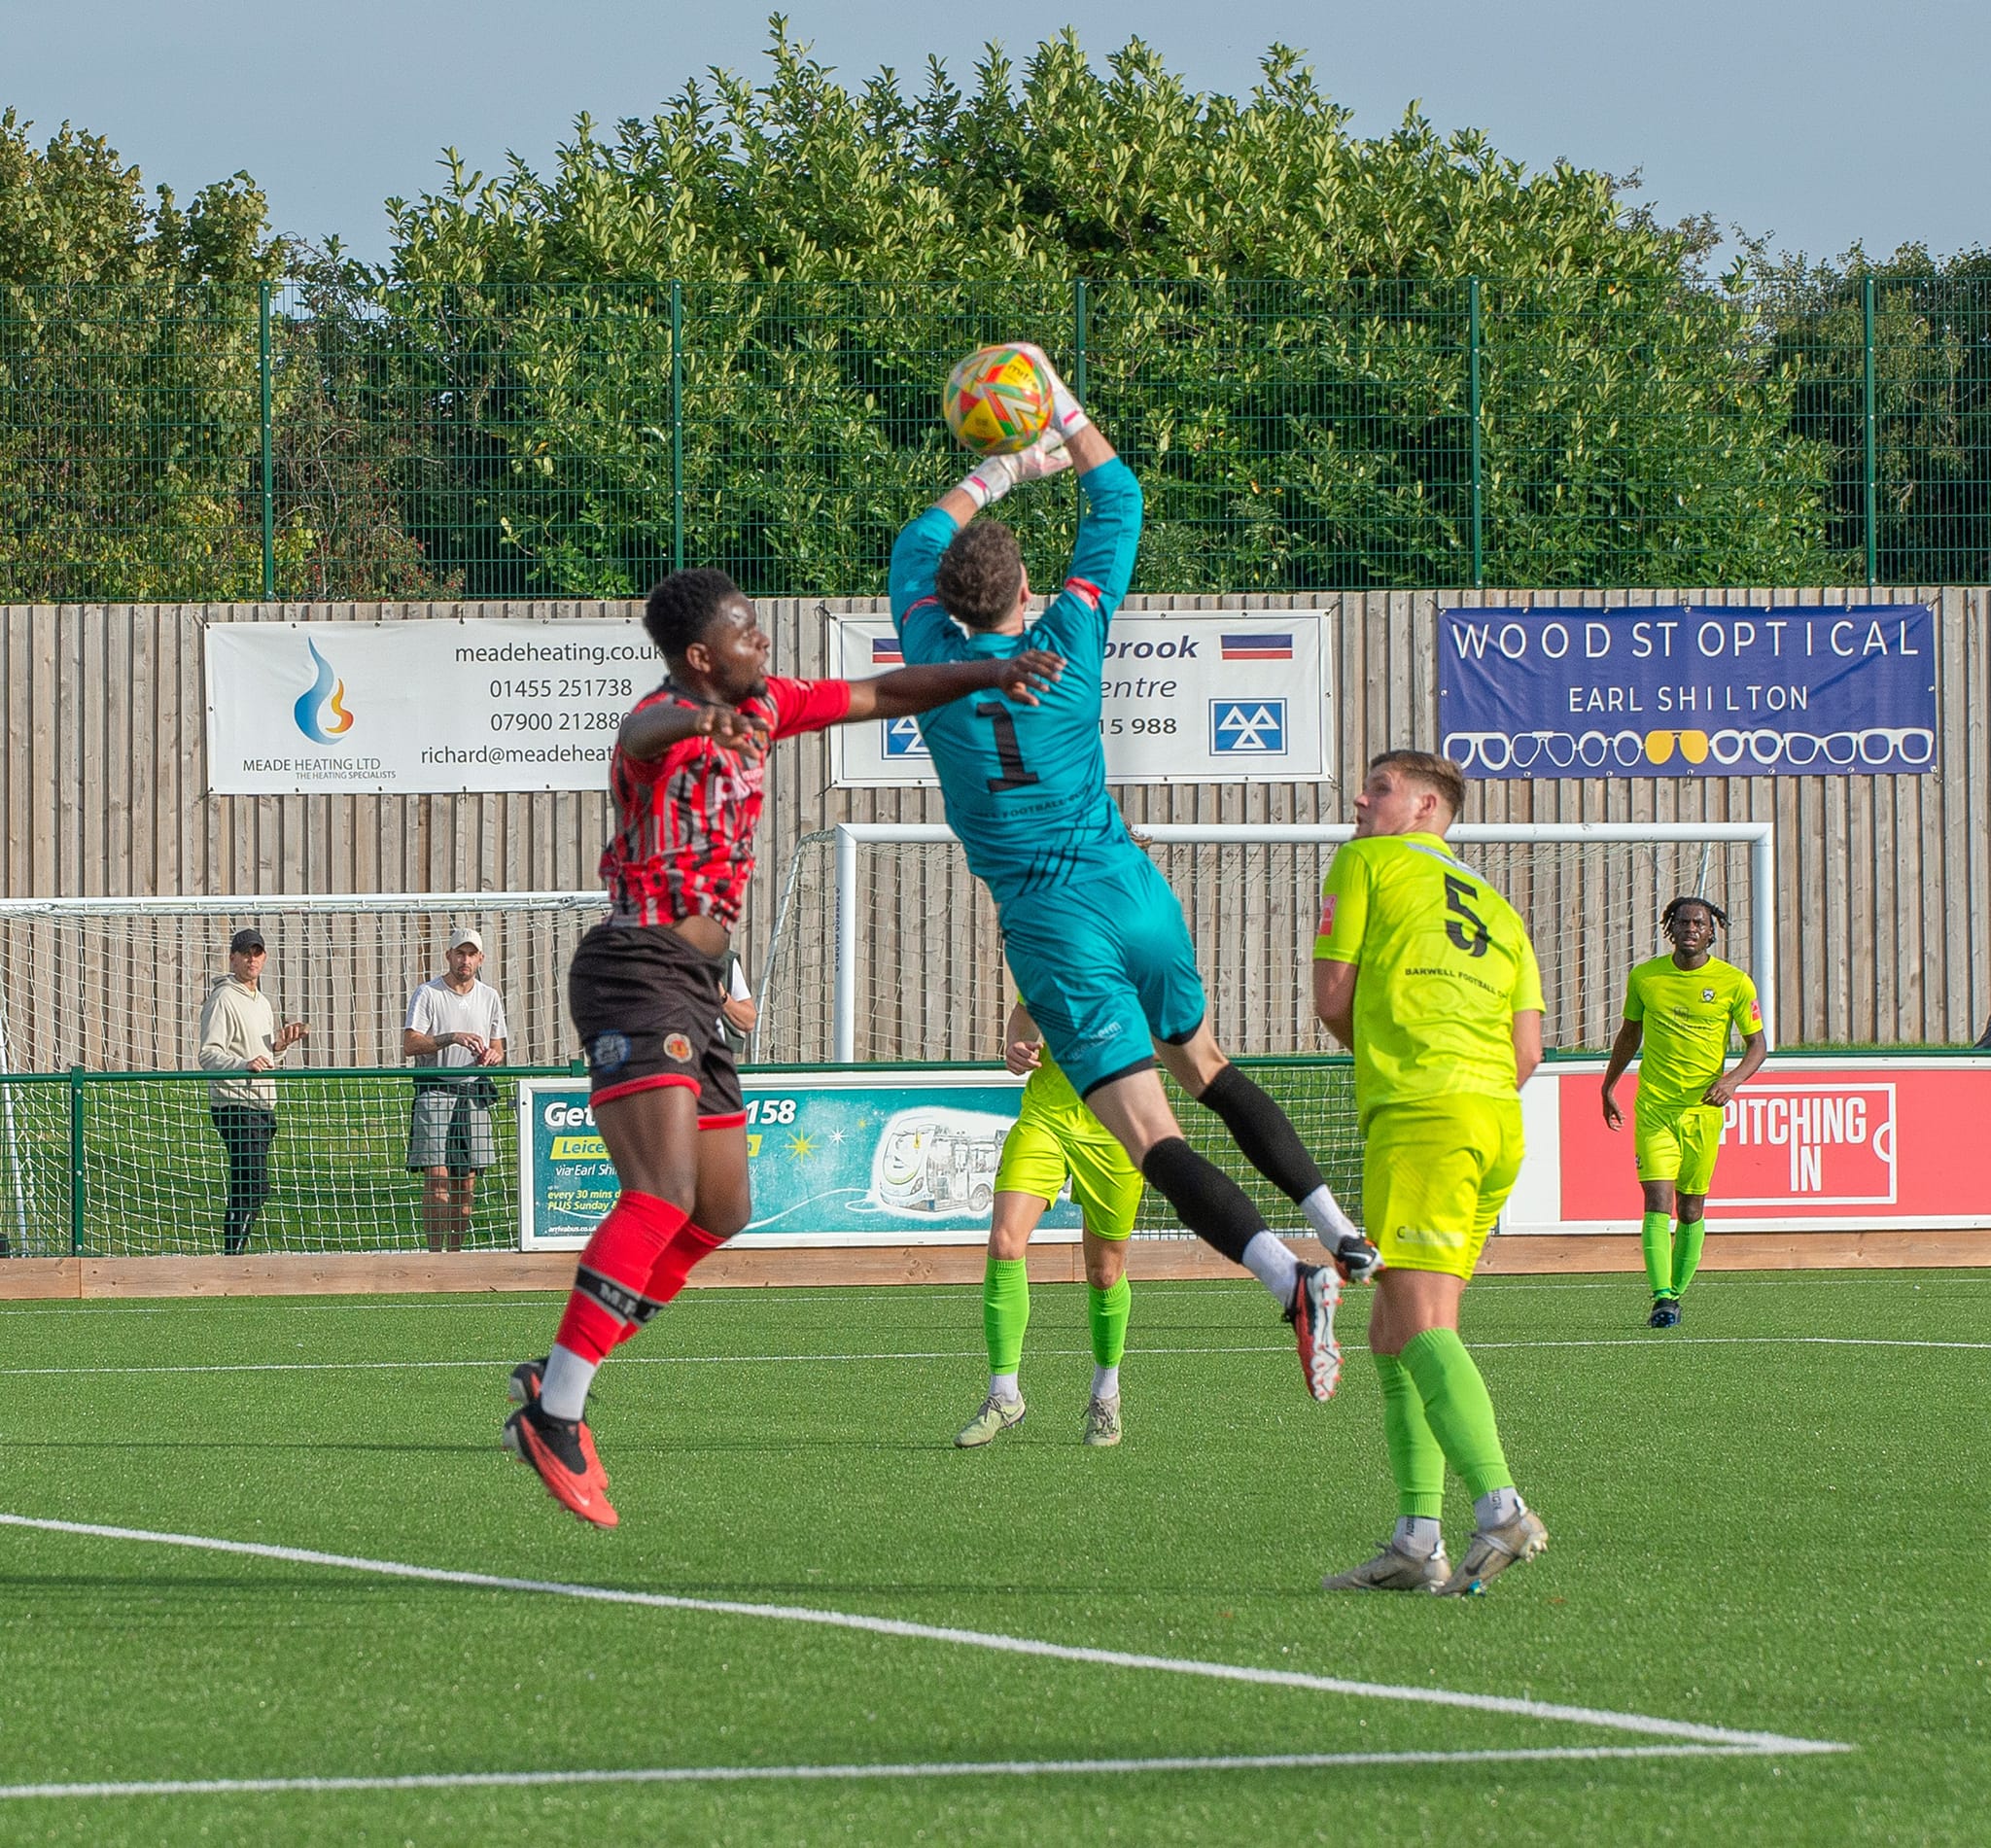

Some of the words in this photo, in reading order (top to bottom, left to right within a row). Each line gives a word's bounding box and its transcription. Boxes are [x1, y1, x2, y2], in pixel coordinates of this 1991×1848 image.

[1452, 622, 1611, 659] WOOD
[1632, 622, 1679, 657] ST
[1697, 619, 1919, 658] OPTICAL
[455, 643, 664, 665] meadeheating.co.uk
[490, 680, 551, 698] 01455
[558, 679, 632, 697] 251738
[1569, 686, 1643, 713] EARL
[1658, 684, 1808, 712] SHILTON
[490, 713, 552, 731] 07900
[1131, 718, 1177, 734] 988
[421, 744, 613, 765] richard@meadeheat
[975, 702, 1039, 792] 1
[243, 759, 291, 771] MEADE
[295, 758, 353, 771] HEATING
[357, 758, 381, 770] LTD
[1444, 872, 1488, 958] 5
[1405, 967, 1456, 978] BARWELL
[1458, 971, 1497, 995] FOOTBALL
[746, 1098, 797, 1125] 158
[1719, 1097, 1867, 1145] PITCHING
[555, 1165, 572, 1176] via
[575, 1164, 596, 1176] Earl
[547, 1190, 575, 1202] every
[576, 1190, 588, 1199] 30
[590, 1189, 612, 1199] mins
[547, 1201, 572, 1211] PLUS
[574, 1200, 609, 1212] Sunday
